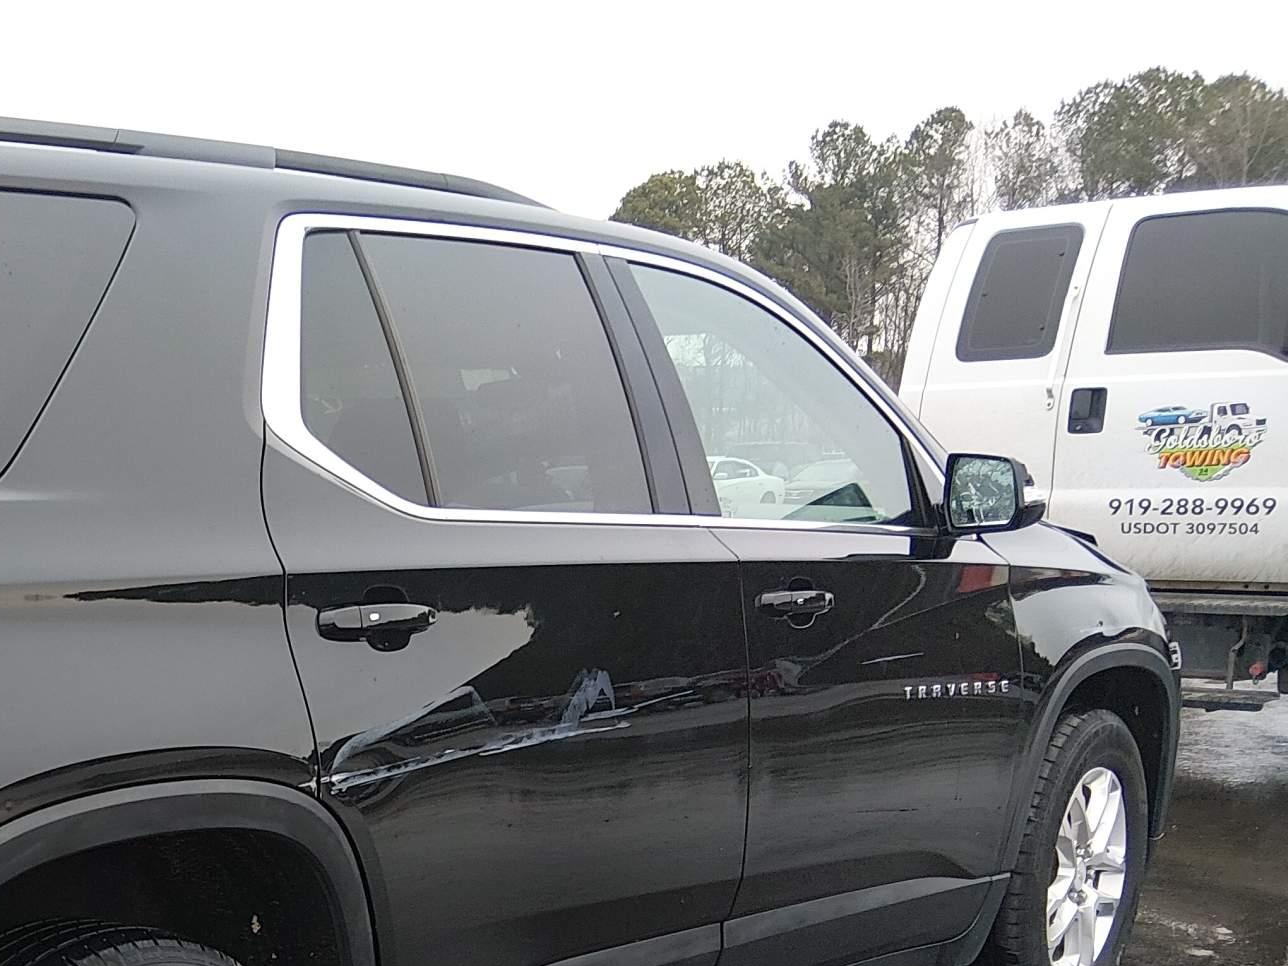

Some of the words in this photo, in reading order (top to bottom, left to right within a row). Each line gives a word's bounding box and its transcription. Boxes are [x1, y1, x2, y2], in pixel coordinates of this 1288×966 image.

[1144, 423, 1266, 454] Goldsboro
[1158, 448, 1251, 469] TOWING
[1108, 497, 1278, 516] 919-288-9969
[1120, 522, 1181, 536] USDOT
[1185, 522, 1261, 536] 3097504
[903, 679, 1010, 701] TRAVERSE
